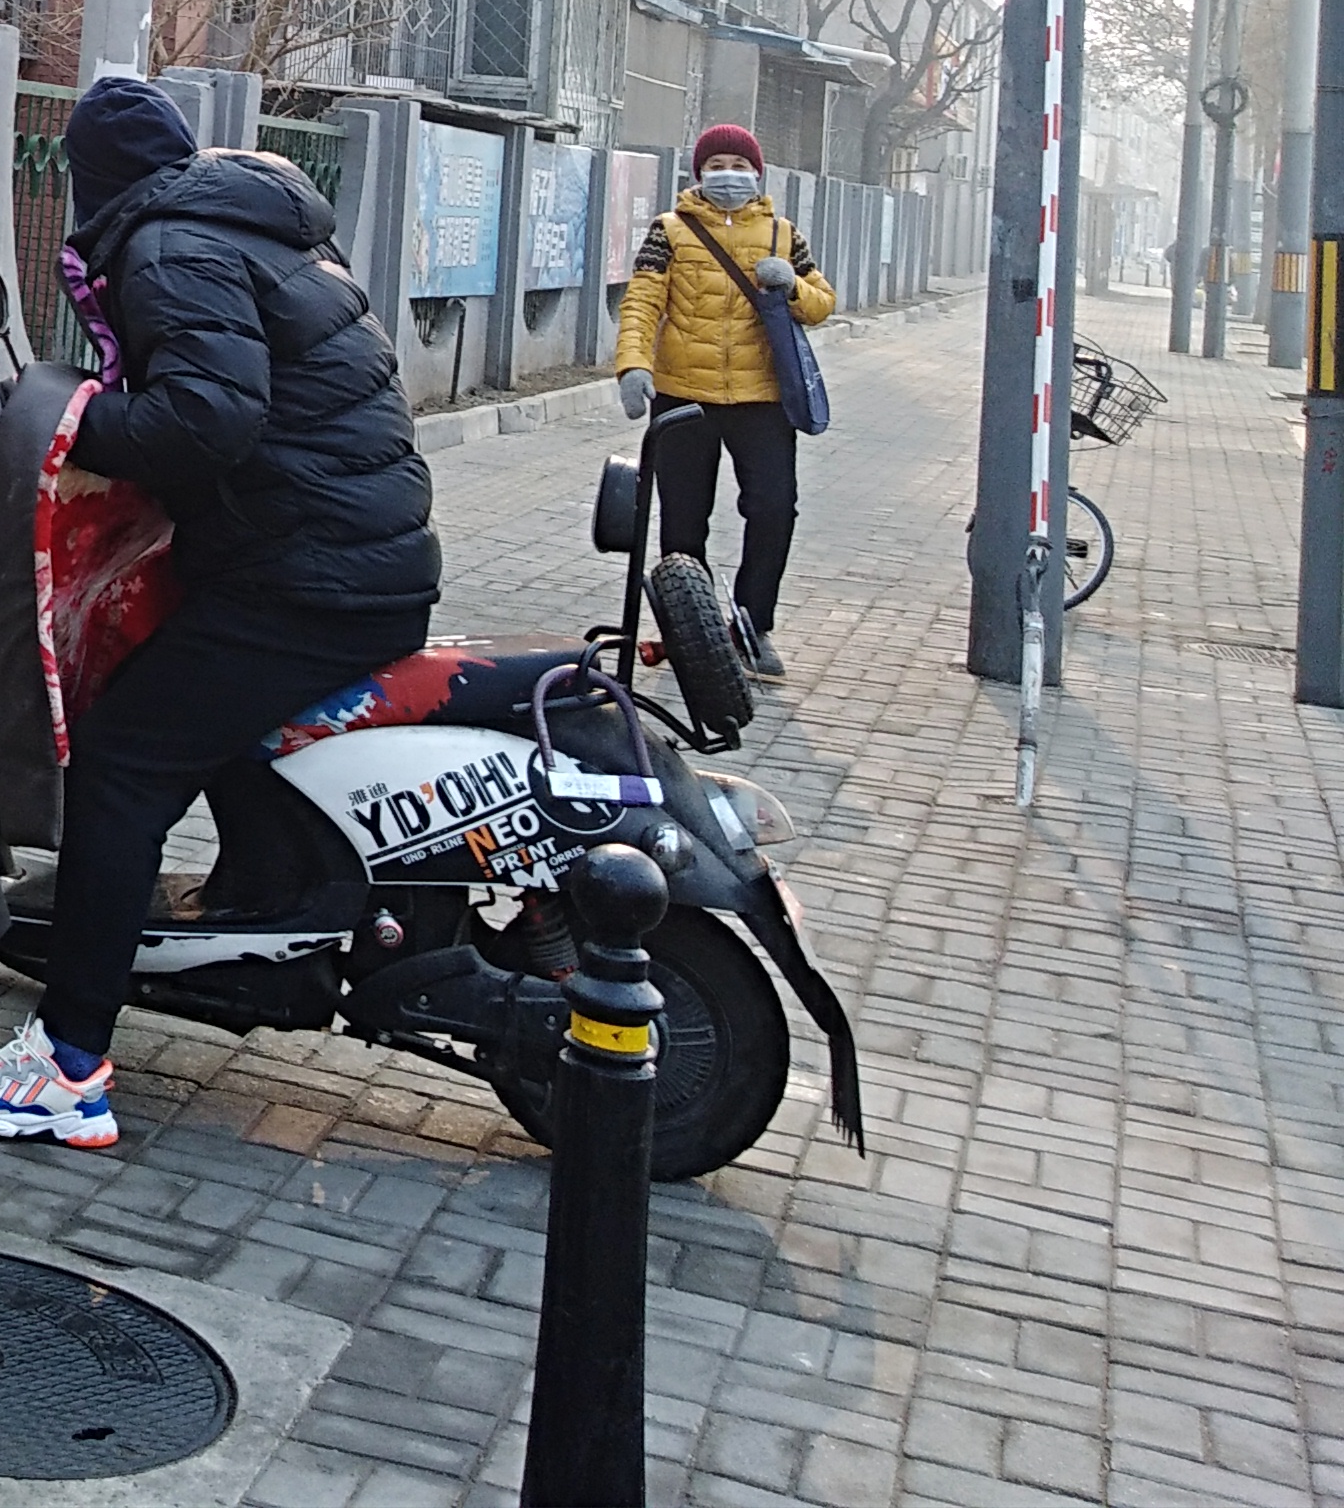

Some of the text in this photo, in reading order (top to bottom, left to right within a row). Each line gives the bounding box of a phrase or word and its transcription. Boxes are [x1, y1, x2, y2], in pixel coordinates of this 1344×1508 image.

[347, 782, 391, 807] 雅迪
[465, 807, 540, 866] NEO
[490, 836, 557, 876] PRINT
